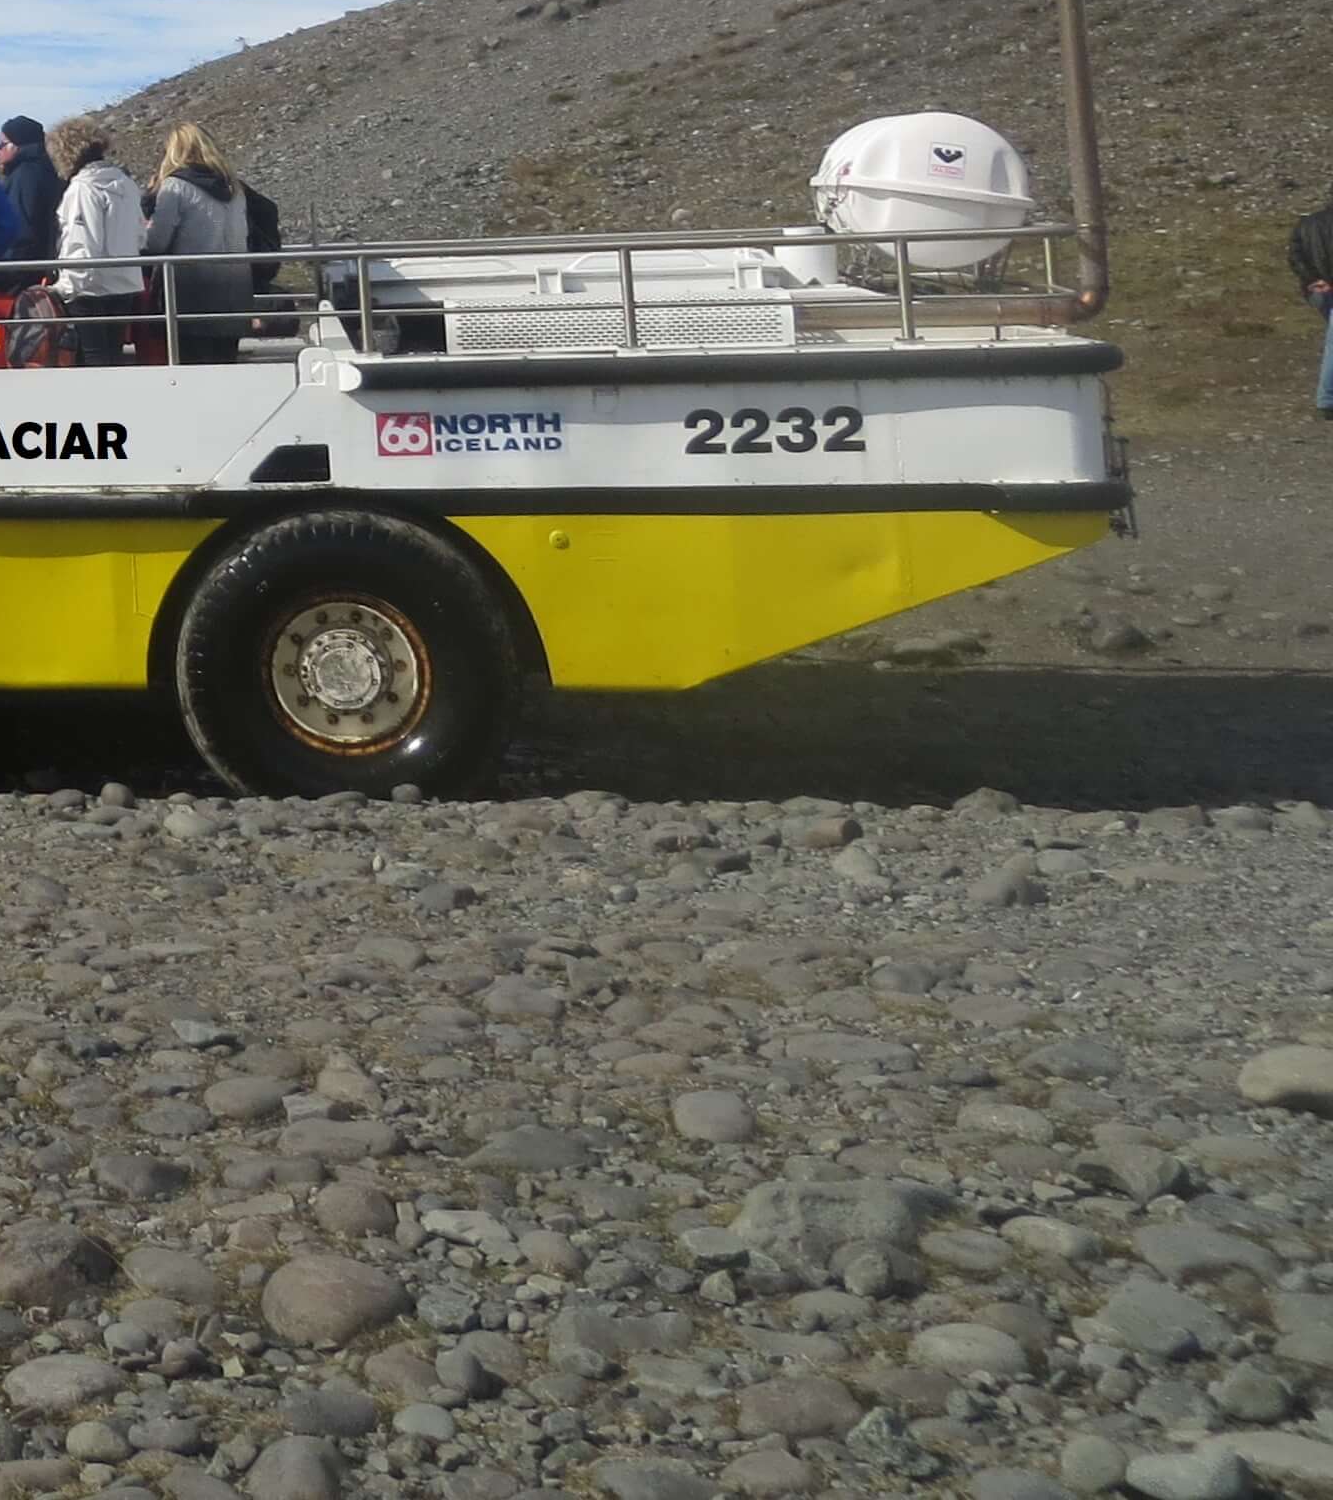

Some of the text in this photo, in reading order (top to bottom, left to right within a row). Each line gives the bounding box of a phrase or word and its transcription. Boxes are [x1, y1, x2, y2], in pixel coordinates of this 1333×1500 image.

[434, 412, 561, 435] NORTH
[683, 405, 866, 454] 2232
[435, 437, 563, 453] ICELAND
